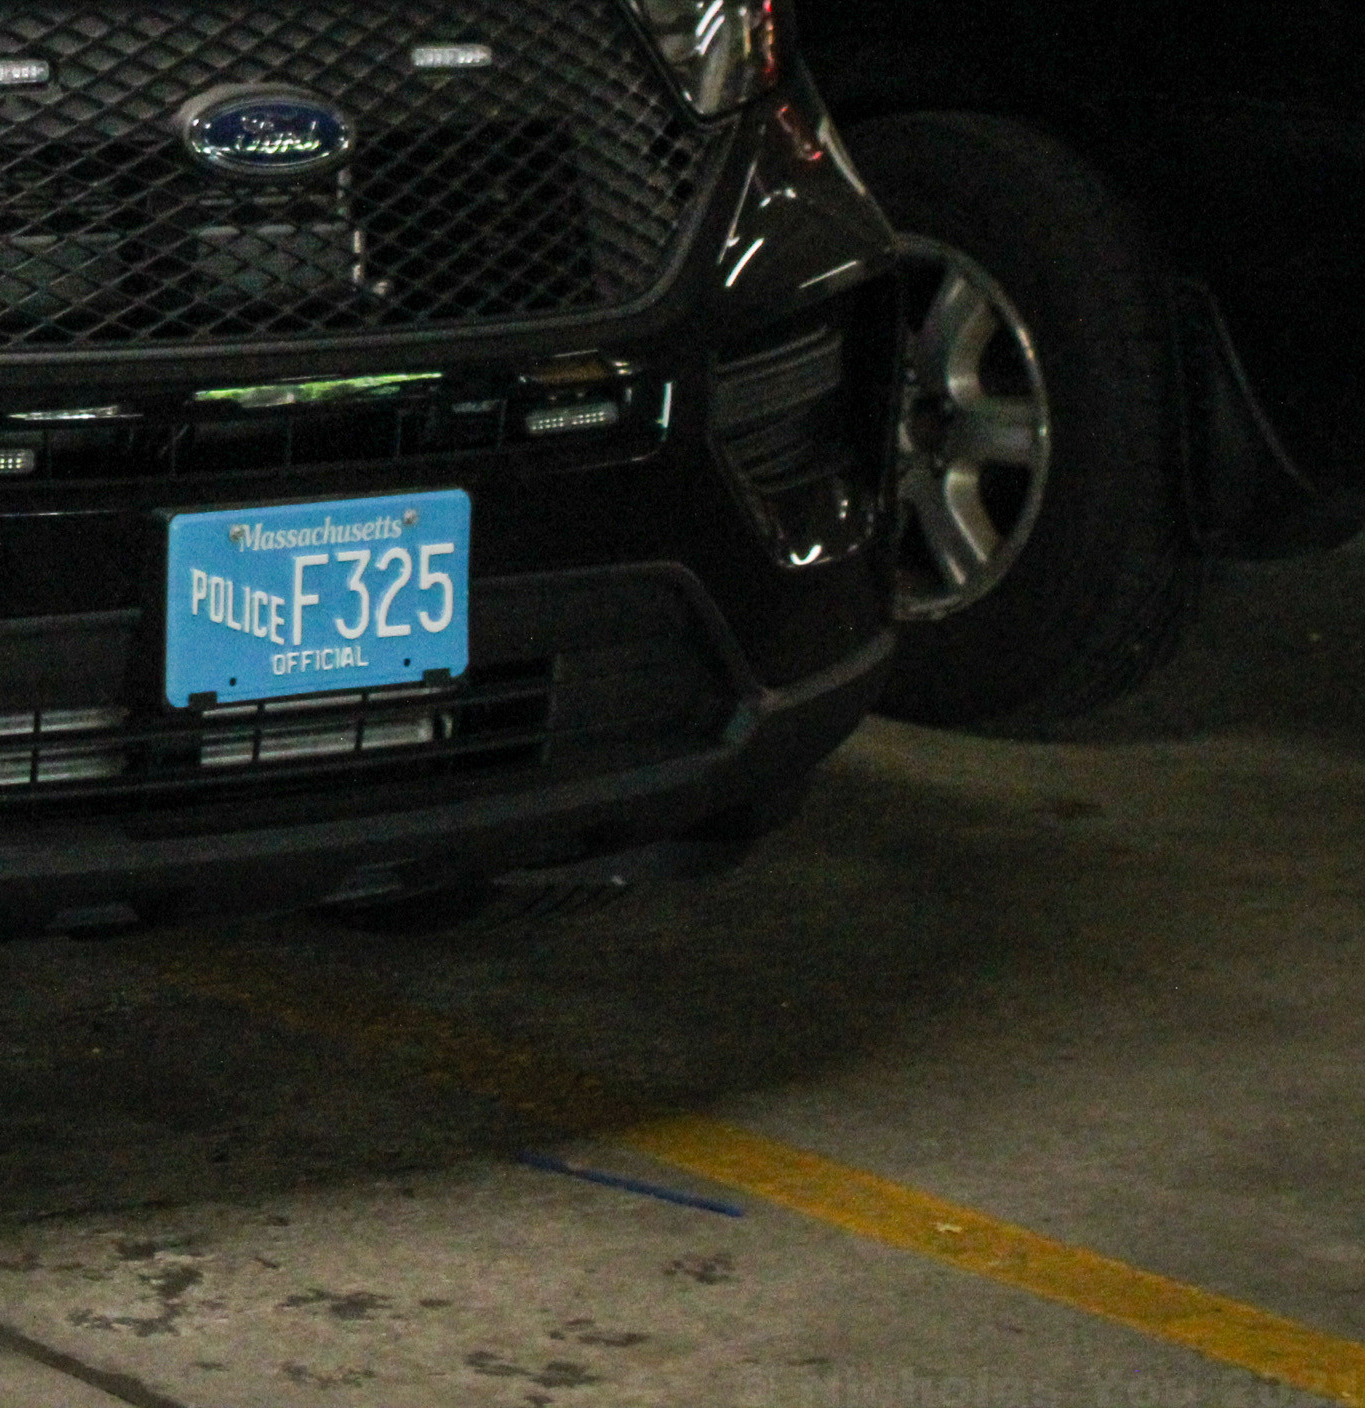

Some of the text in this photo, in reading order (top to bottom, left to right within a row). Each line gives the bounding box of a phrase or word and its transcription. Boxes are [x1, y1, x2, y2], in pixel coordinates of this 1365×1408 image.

[224, 115, 322, 155] Ford
[239, 516, 402, 552] Massachusetts
[191, 542, 455, 646] POLICE F325
[272, 645, 369, 676] OFFICIAL
